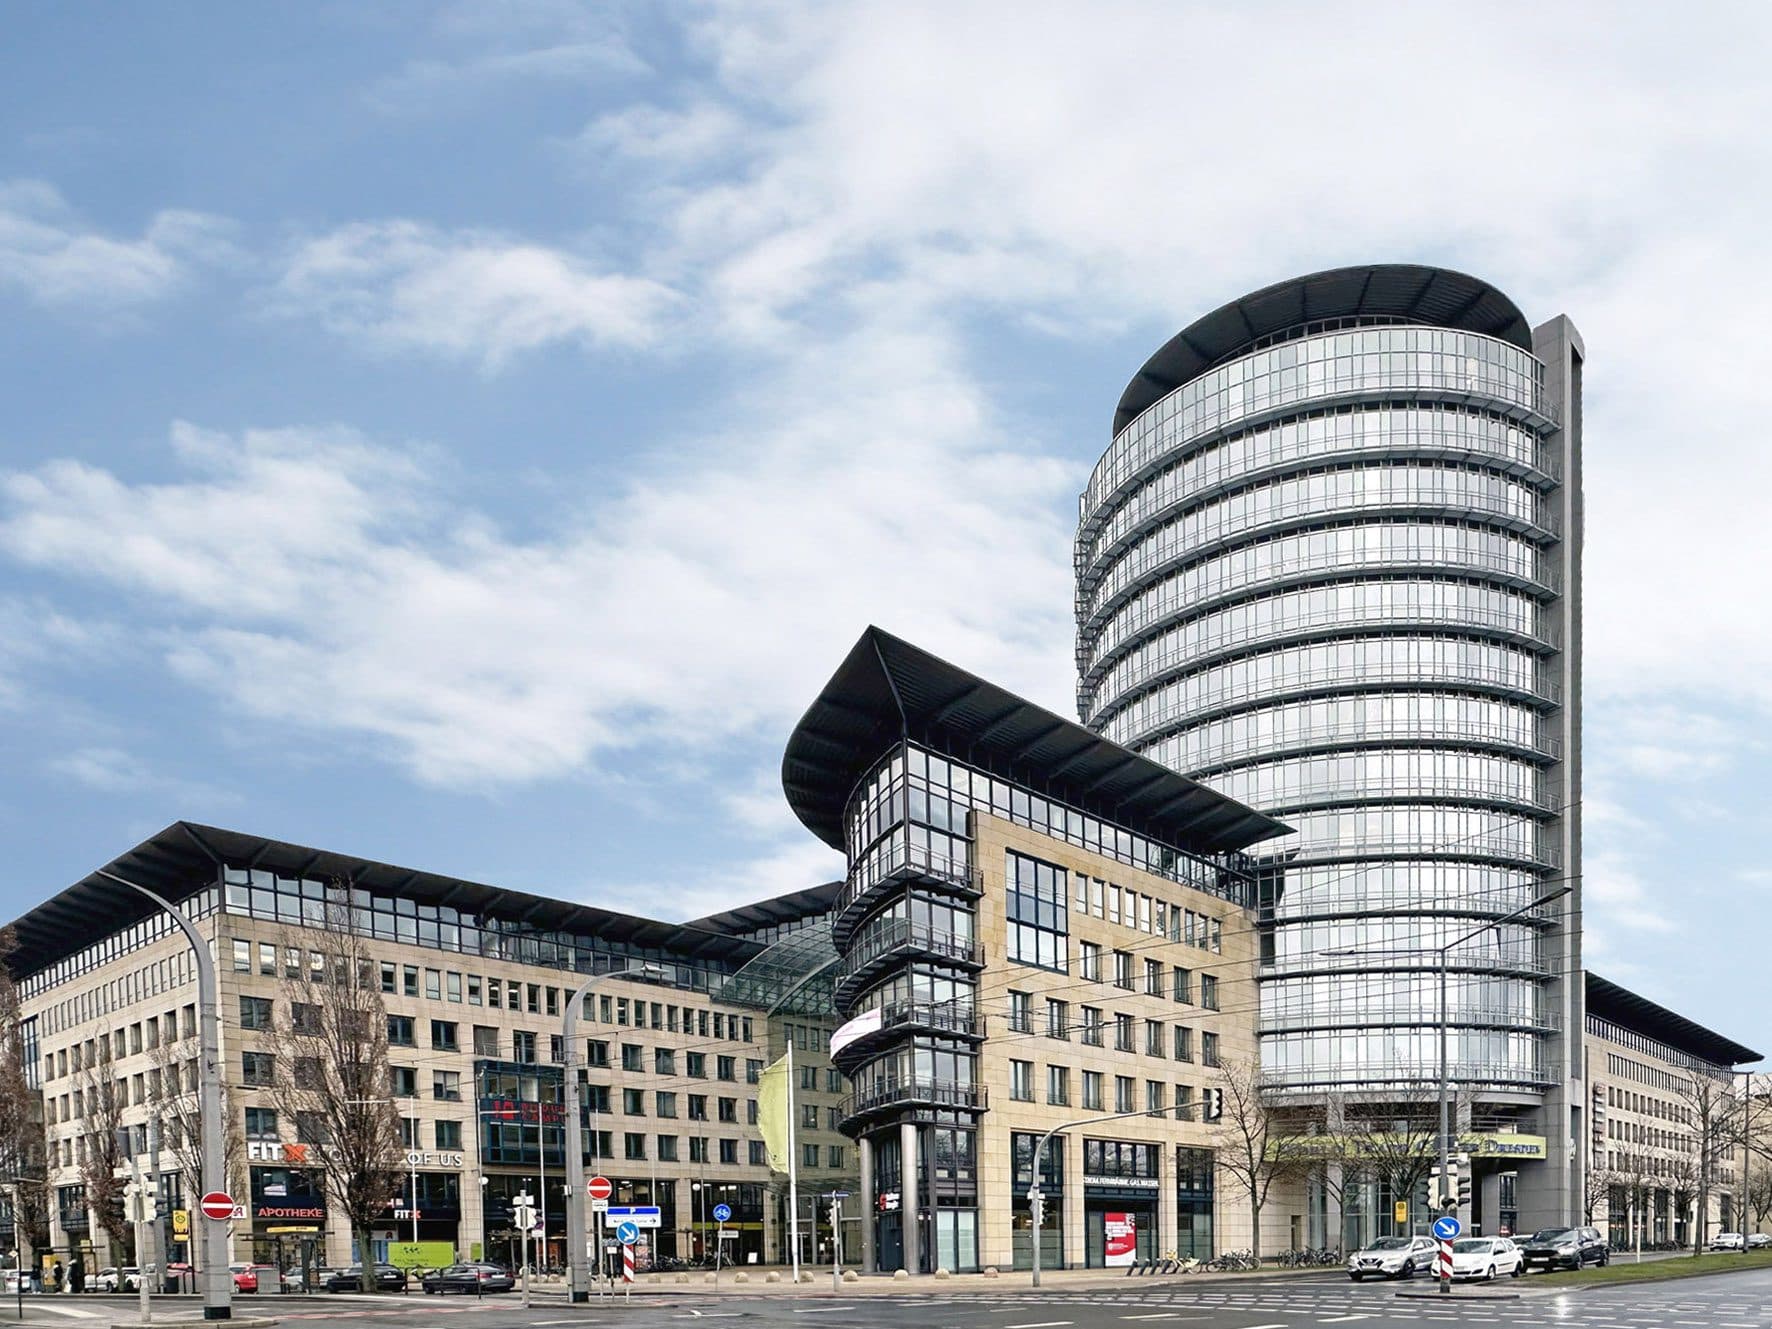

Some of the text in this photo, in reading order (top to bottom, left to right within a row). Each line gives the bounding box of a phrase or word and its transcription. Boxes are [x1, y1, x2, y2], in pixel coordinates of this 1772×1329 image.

[408, 1152, 432, 1165] OF
[439, 1152, 463, 1167] US
[258, 1207, 325, 1218] APOTHEKE
